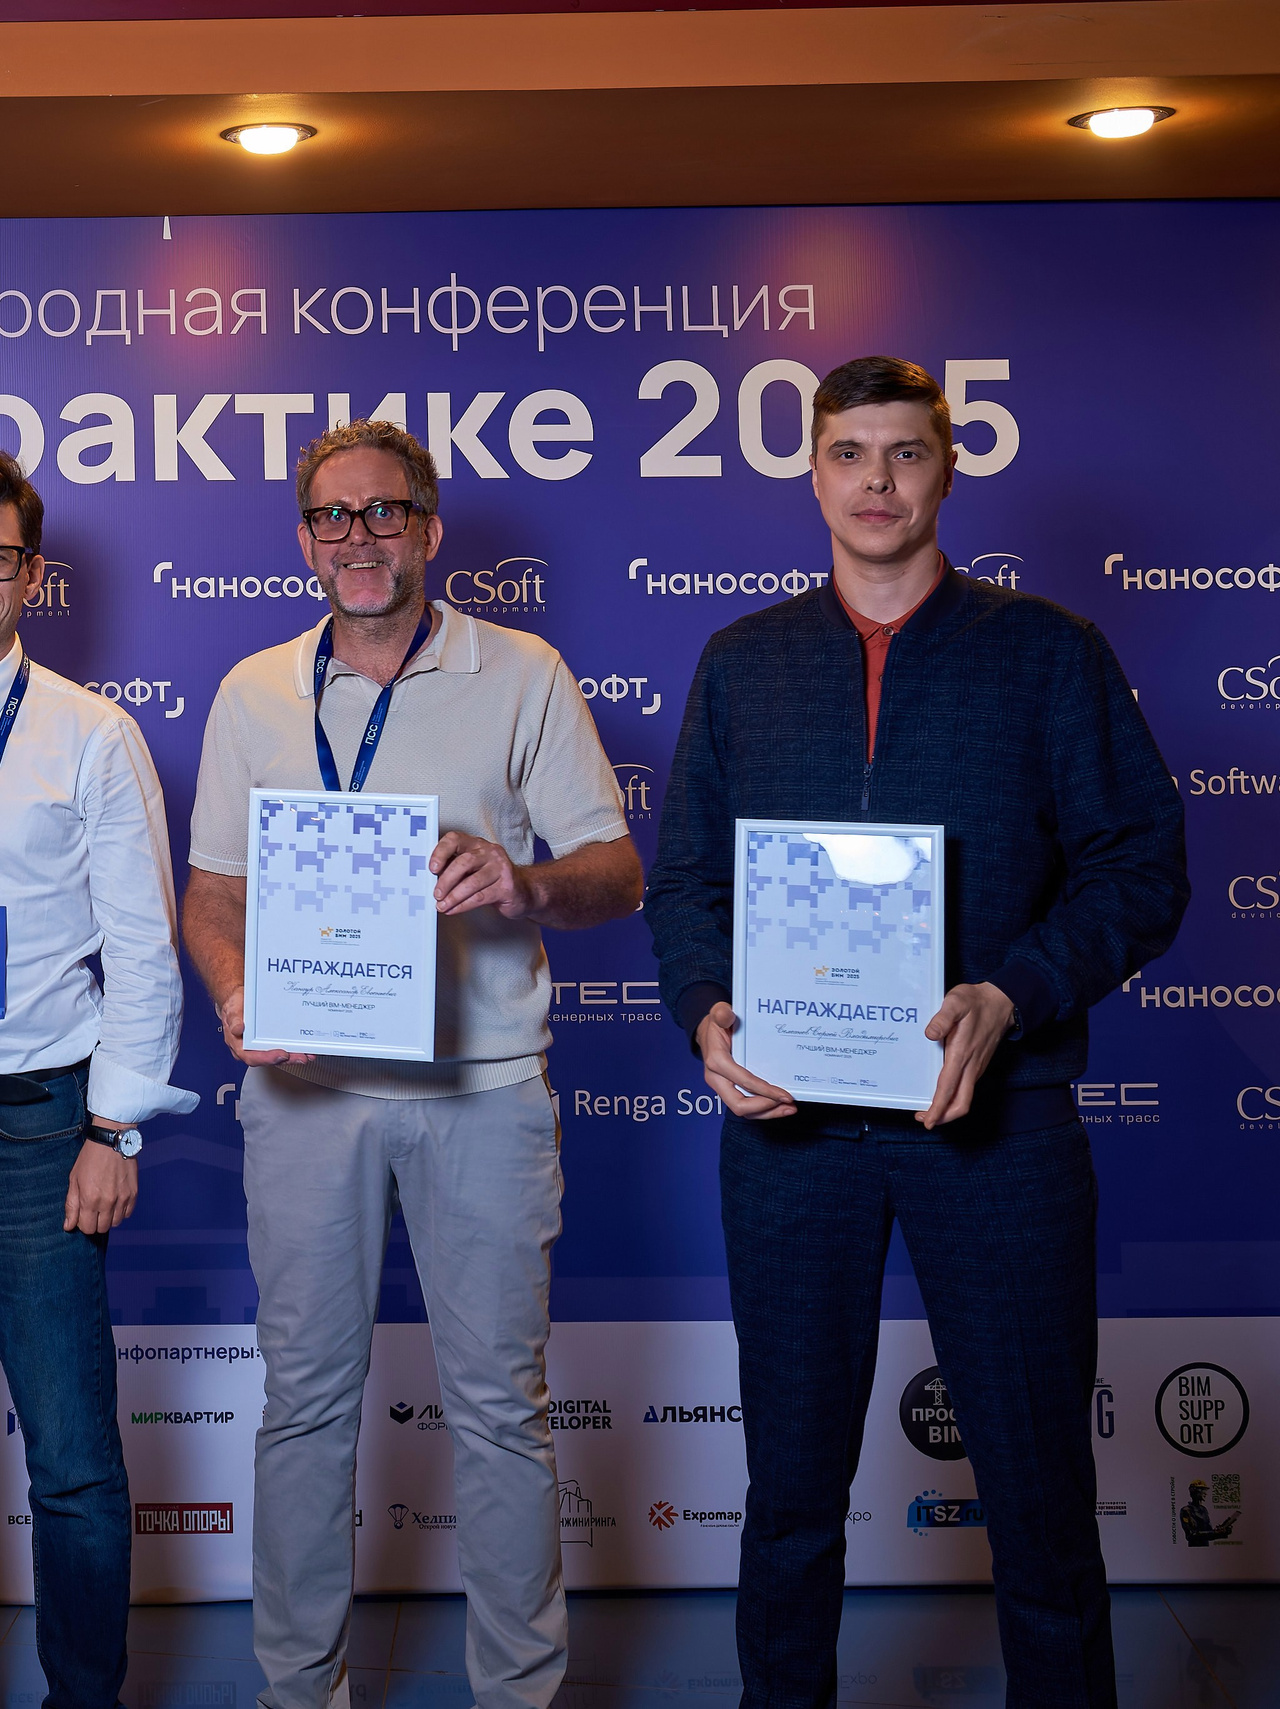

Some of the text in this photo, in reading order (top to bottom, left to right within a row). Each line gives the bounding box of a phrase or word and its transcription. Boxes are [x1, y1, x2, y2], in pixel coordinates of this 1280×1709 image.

[293, 272, 816, 351] конференция
[639, 357, 1021, 479] 205
[169, 571, 328, 602] нанософ
[445, 566, 547, 604] CSoft
[1120, 561, 1280, 594] нанософ
[457, 605, 547, 614] evelopment
[364, 723, 379, 746] ПСС
[267, 957, 413, 980] НАГРАЖДАЕТСЯ
[620, 1011, 662, 1024] трасс
[757, 998, 918, 1024] НАГРАЖДАЕТСЯ
[574, 1089, 666, 1123] Renga
[1118, 1114, 1161, 1126] трасс
[117, 1343, 261, 1365] нфопартнеры:
[1178, 1375, 1212, 1397] BIM
[131, 1410, 235, 1424] МИРКВАРТИР
[1178, 1399, 1226, 1421] SUPP
[1180, 1422, 1214, 1445] ORT
[137, 1509, 231, 1532] ТОЧКА ОПОРЫ
[682, 1509, 743, 1523] Expomap
